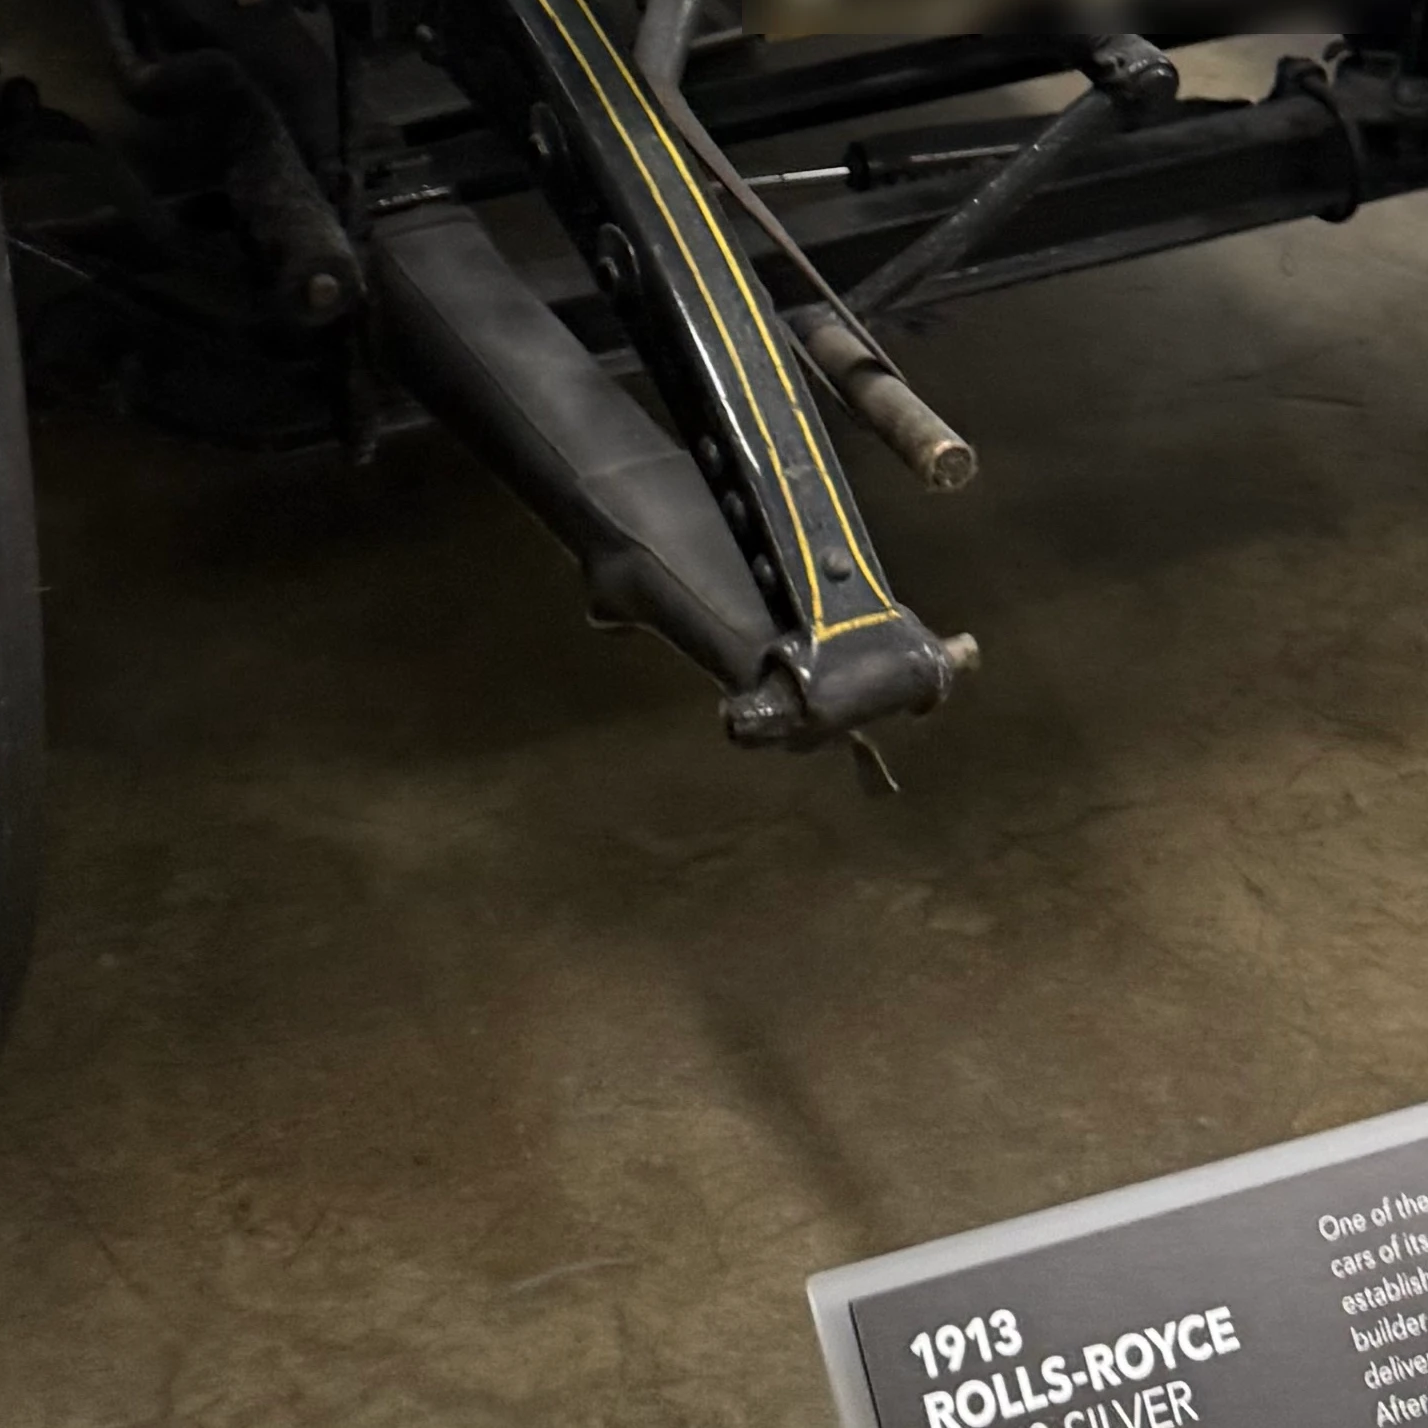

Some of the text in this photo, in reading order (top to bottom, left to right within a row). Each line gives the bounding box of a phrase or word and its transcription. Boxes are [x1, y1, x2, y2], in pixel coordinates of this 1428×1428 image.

[1319, 1214, 1366, 1241] One
[1371, 1197, 1392, 1226] of
[1331, 1250, 1376, 1278] cars
[1379, 1234, 1401, 1263] of
[910, 1309, 1023, 1379] 1913
[1350, 1313, 1427, 1351] builder
[923, 1305, 1241, 1428] ROLLS-ROYCE
[1377, 1394, 1428, 1428] After
